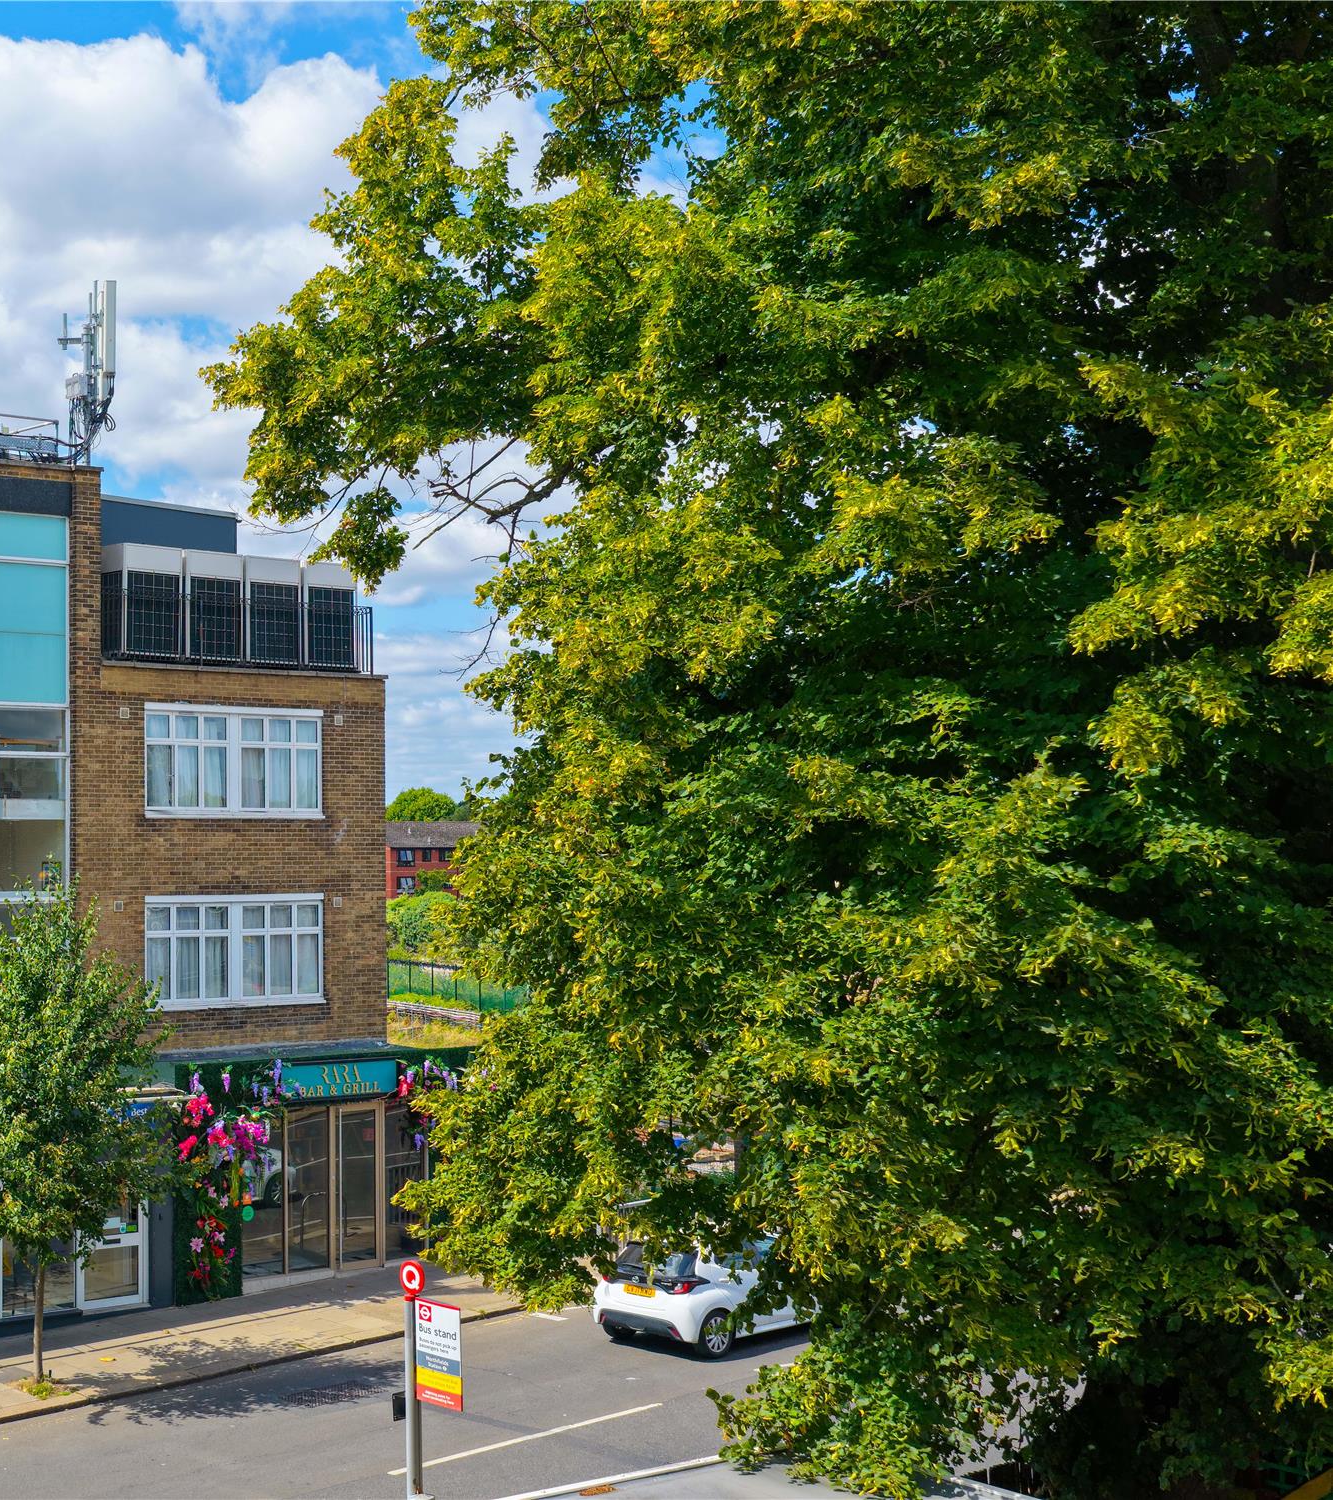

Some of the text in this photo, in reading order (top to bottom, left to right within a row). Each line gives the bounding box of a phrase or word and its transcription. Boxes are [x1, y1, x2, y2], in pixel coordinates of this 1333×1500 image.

[299, 1081, 380, 1097] BAR & GRILL
[418, 1323, 457, 1341] Bus stand
